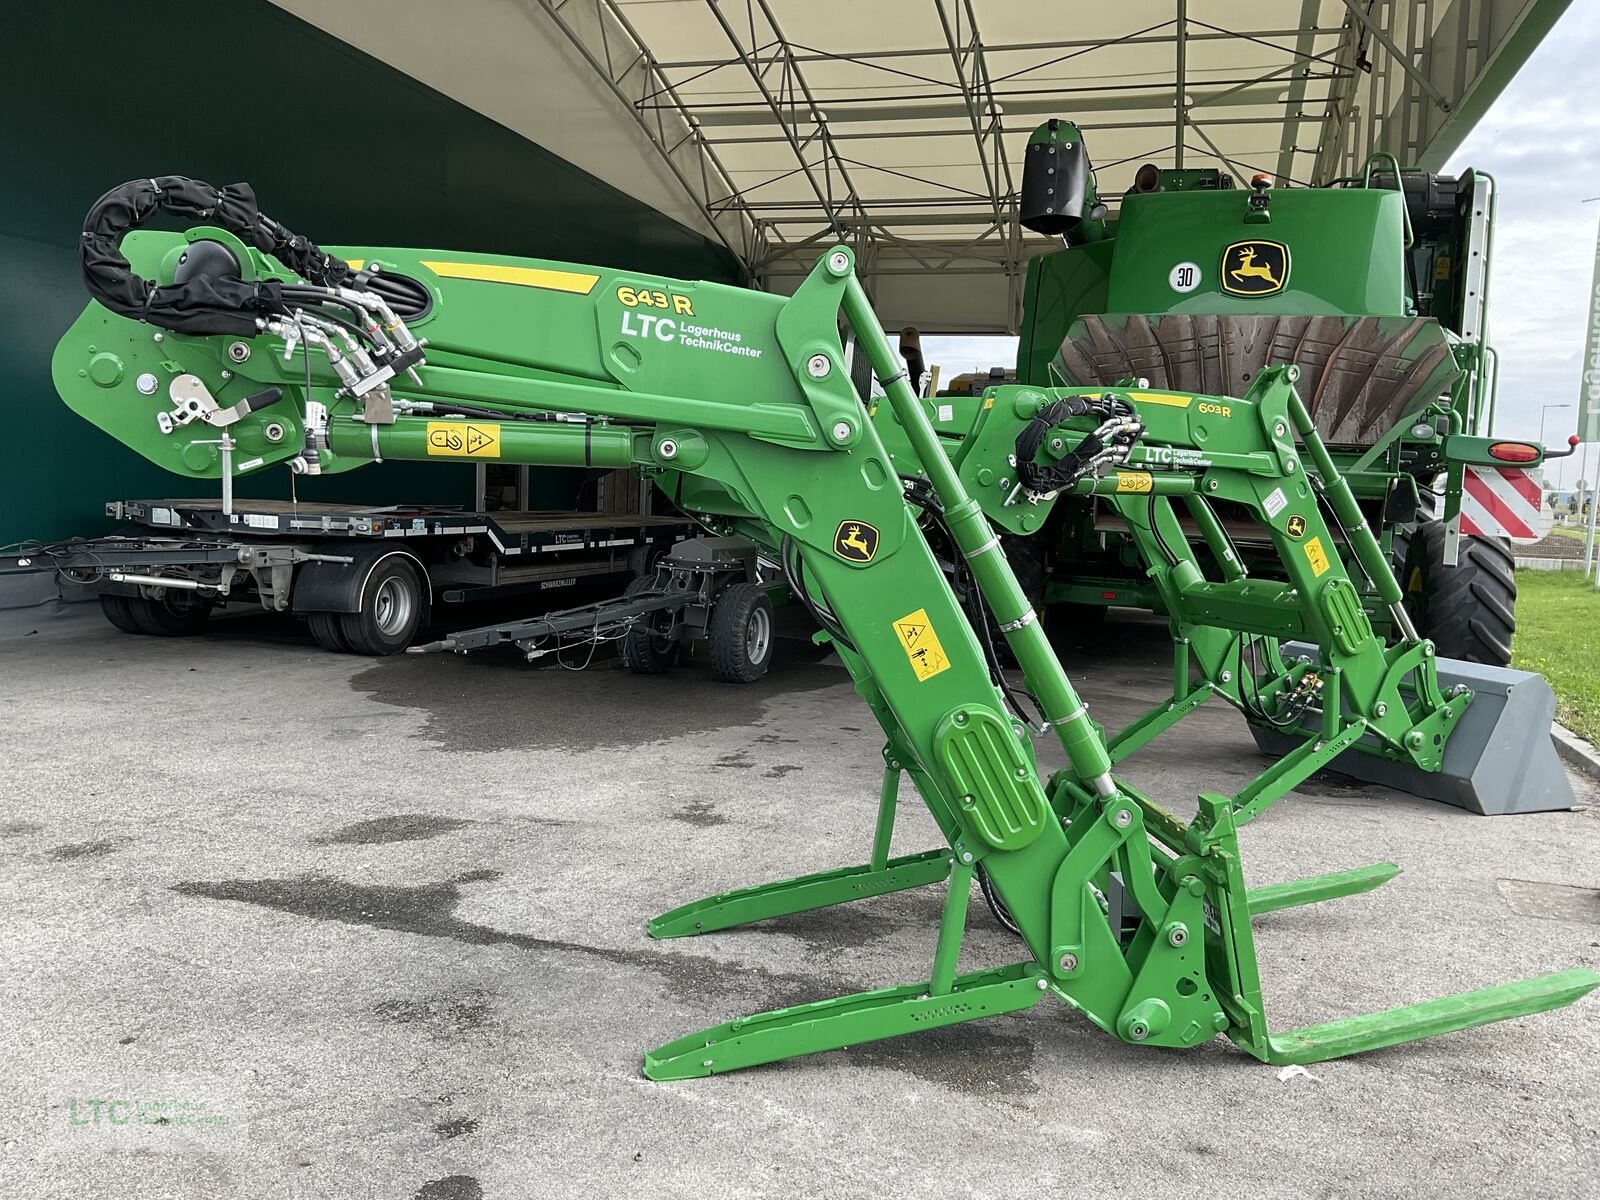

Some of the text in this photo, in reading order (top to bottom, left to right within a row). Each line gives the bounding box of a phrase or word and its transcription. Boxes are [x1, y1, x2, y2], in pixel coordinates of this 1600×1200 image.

[1177, 267, 1193, 287] 30
[616, 286, 696, 317] 643 R
[621, 311, 676, 342] LTC
[679, 321, 742, 341] Lagerhaus
[679, 333, 762, 358] TechnikCenter
[1145, 447, 1172, 463] LTC
[555, 534, 567, 544] LTC
